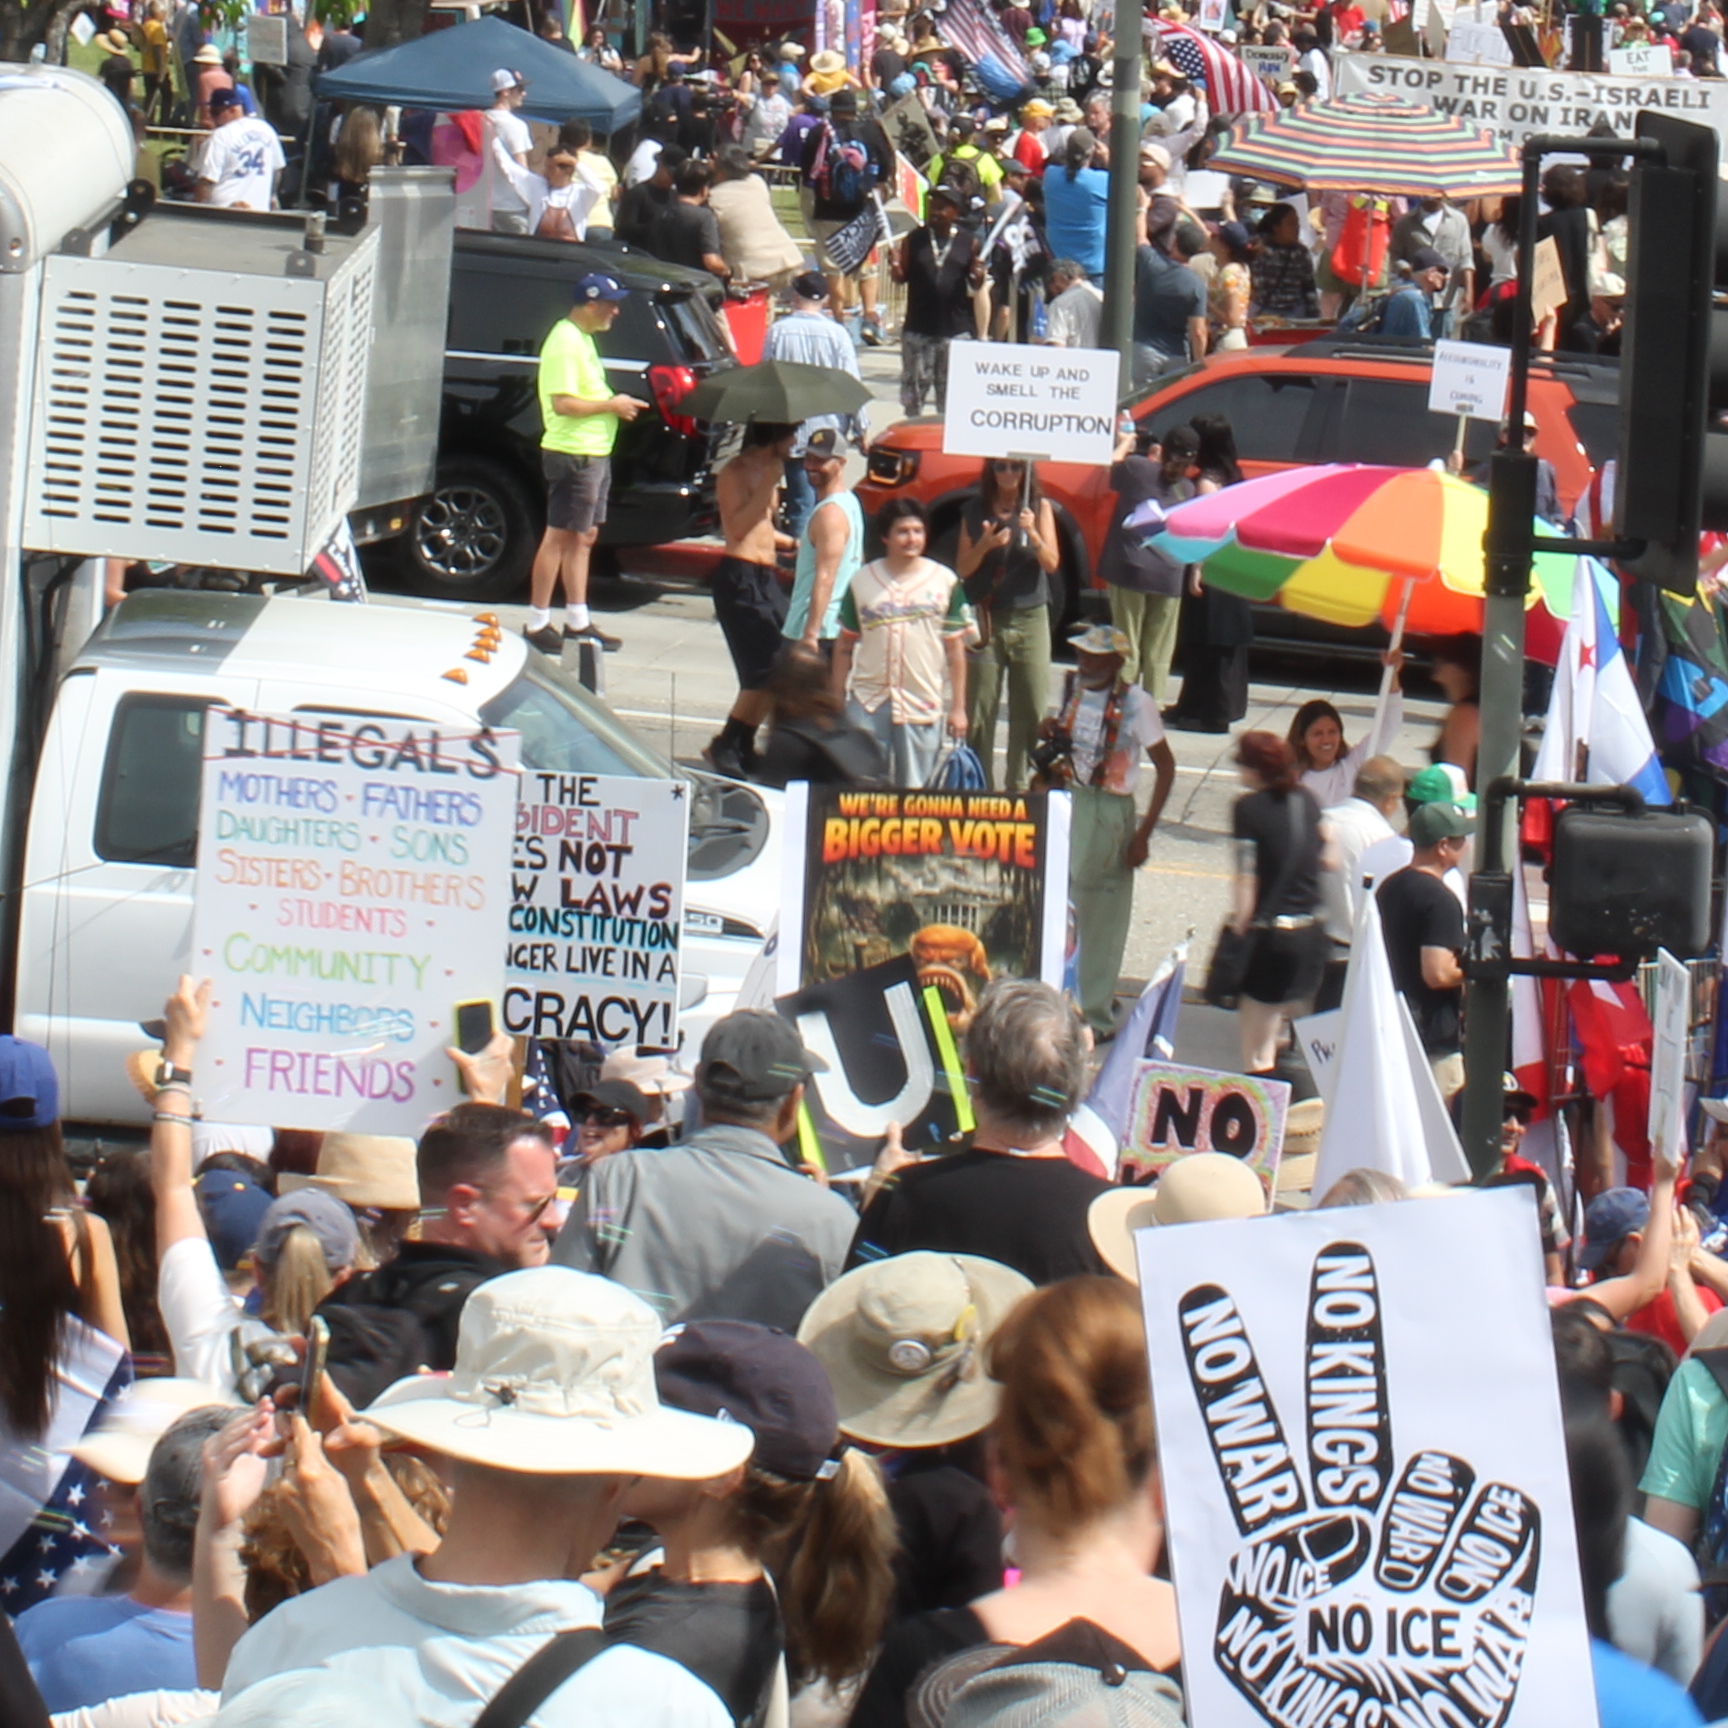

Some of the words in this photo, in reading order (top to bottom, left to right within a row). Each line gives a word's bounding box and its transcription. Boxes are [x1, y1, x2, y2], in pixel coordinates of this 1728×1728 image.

[1368, 65, 1444, 90] STOP
[1453, 73, 1508, 98] THE
[1626, 50, 1652, 64] EAT
[1431, 95, 1499, 120] WAR
[1508, 103, 1551, 125] ON
[1561, 106, 1633, 131] IRAN
[234, 146, 265, 178] 34
[975, 361, 1022, 376] WAKE
[1030, 365, 1050, 379] UP
[1056, 369, 1090, 383] AND
[986, 384, 1038, 398] SMELL
[1049, 386, 1080, 400] THE
[970, 409, 1113, 435] CORRUPTION
[223, 708, 502, 780] ILLEGALS
[218, 771, 338, 813] MOTHERS
[361, 782, 483, 827] FATHERS
[538, 774, 601, 807] THE
[839, 792, 899, 817] WE'RE
[904, 795, 964, 819] GONNA
[968, 797, 1011, 820] NEED
[1013, 799, 1028, 821] A
[216, 809, 361, 852] DAUGHTERS
[391, 825, 469, 865] SONS
[513, 836, 549, 871] ES
[559, 839, 634, 874] NOT
[516, 807, 640, 849] SIDENT
[823, 817, 943, 864] BIGGER
[948, 819, 1037, 869] VOTE
[215, 848, 322, 892] SISTERS
[339, 858, 486, 911] BROTHERS
[561, 877, 673, 921] LAWS
[277, 898, 408, 939] STUDENTS
[508, 903, 679, 951] CONSTITUTION
[223, 932, 433, 992] COMMUNITY
[505, 942, 558, 973] NGER
[565, 946, 613, 978] LIVE
[619, 951, 650, 982] IN
[656, 954, 677, 985] A
[239, 991, 417, 1042] NEIGHBORS
[503, 986, 673, 1046] CRACY!
[244, 1048, 417, 1104] FRIENDS
[796, 980, 935, 1138] U
[1151, 1087, 1257, 1159] NO
[1313, 1253, 1377, 1330] NO
[1182, 1296, 1252, 1384] NO
[1206, 1376, 1300, 1525] WAR
[1309, 1341, 1380, 1506] KINGS
[1406, 1452, 1455, 1509] NO
[1386, 1495, 1449, 1564] WAR
[1474, 1484, 1523, 1542] ICE
[1230, 1545, 1286, 1610] NO
[1287, 1558, 1332, 1600] ICE
[1458, 1532, 1512, 1590] NO
[1217, 1606, 1279, 1681] NO
[1308, 1604, 1374, 1659] NO
[1387, 1608, 1463, 1659] ICE
